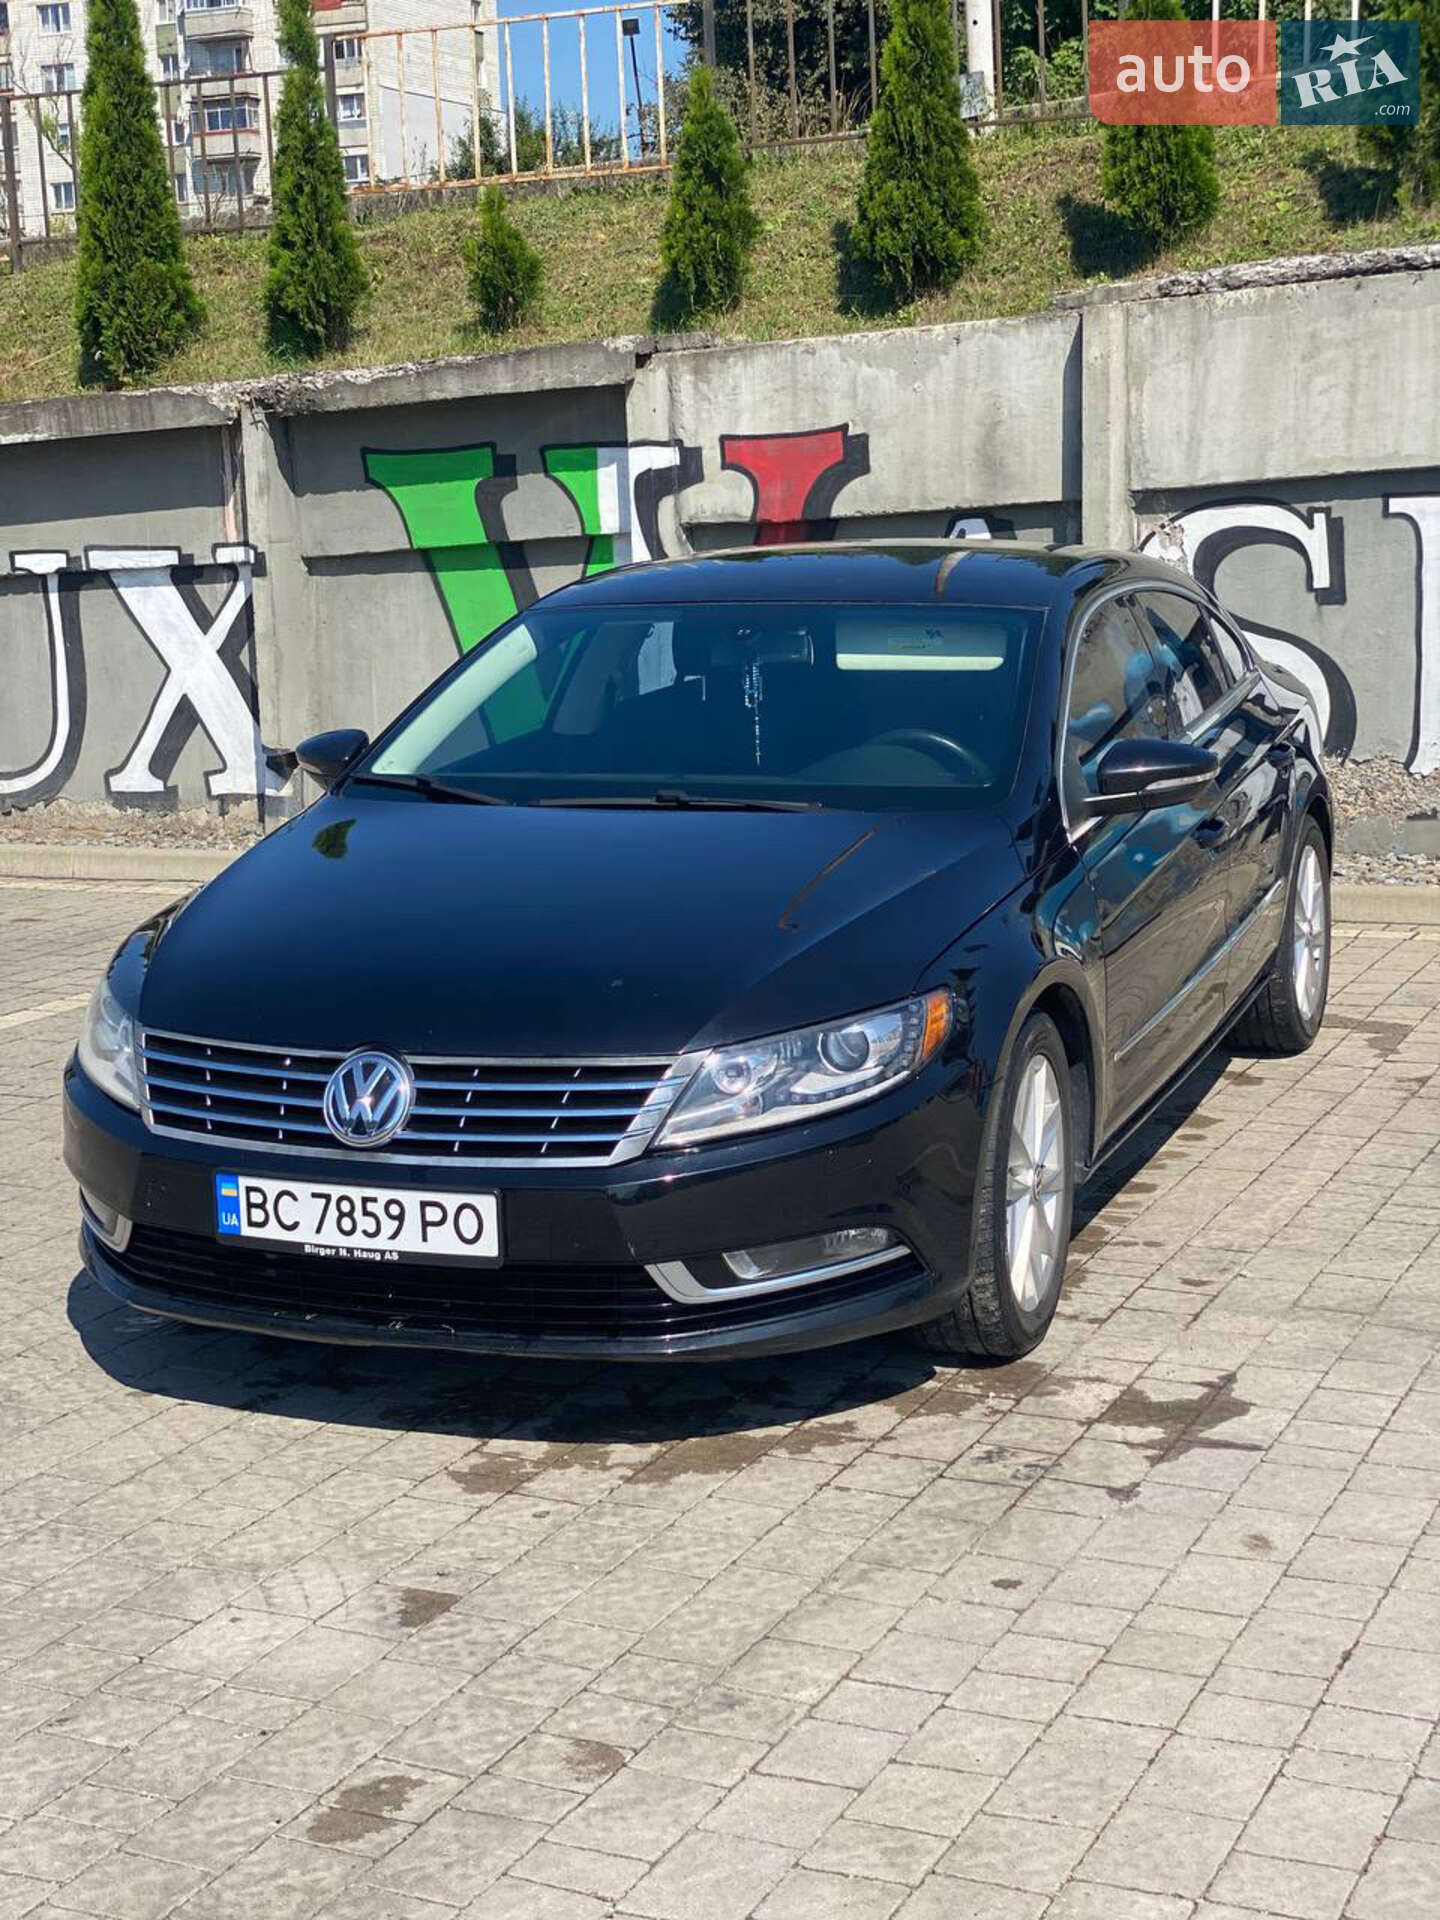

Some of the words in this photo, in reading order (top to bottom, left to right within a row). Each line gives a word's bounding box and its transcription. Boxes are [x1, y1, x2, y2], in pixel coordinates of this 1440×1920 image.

[222, 1212, 239, 1227] UA
[245, 1185, 300, 1231] BC
[311, 1192, 406, 1240] 7859
[419, 1200, 484, 1245] PO
[304, 1244, 336, 1257] Birger
[354, 1249, 382, 1261] Haug
[384, 1251, 399, 1261] AS
